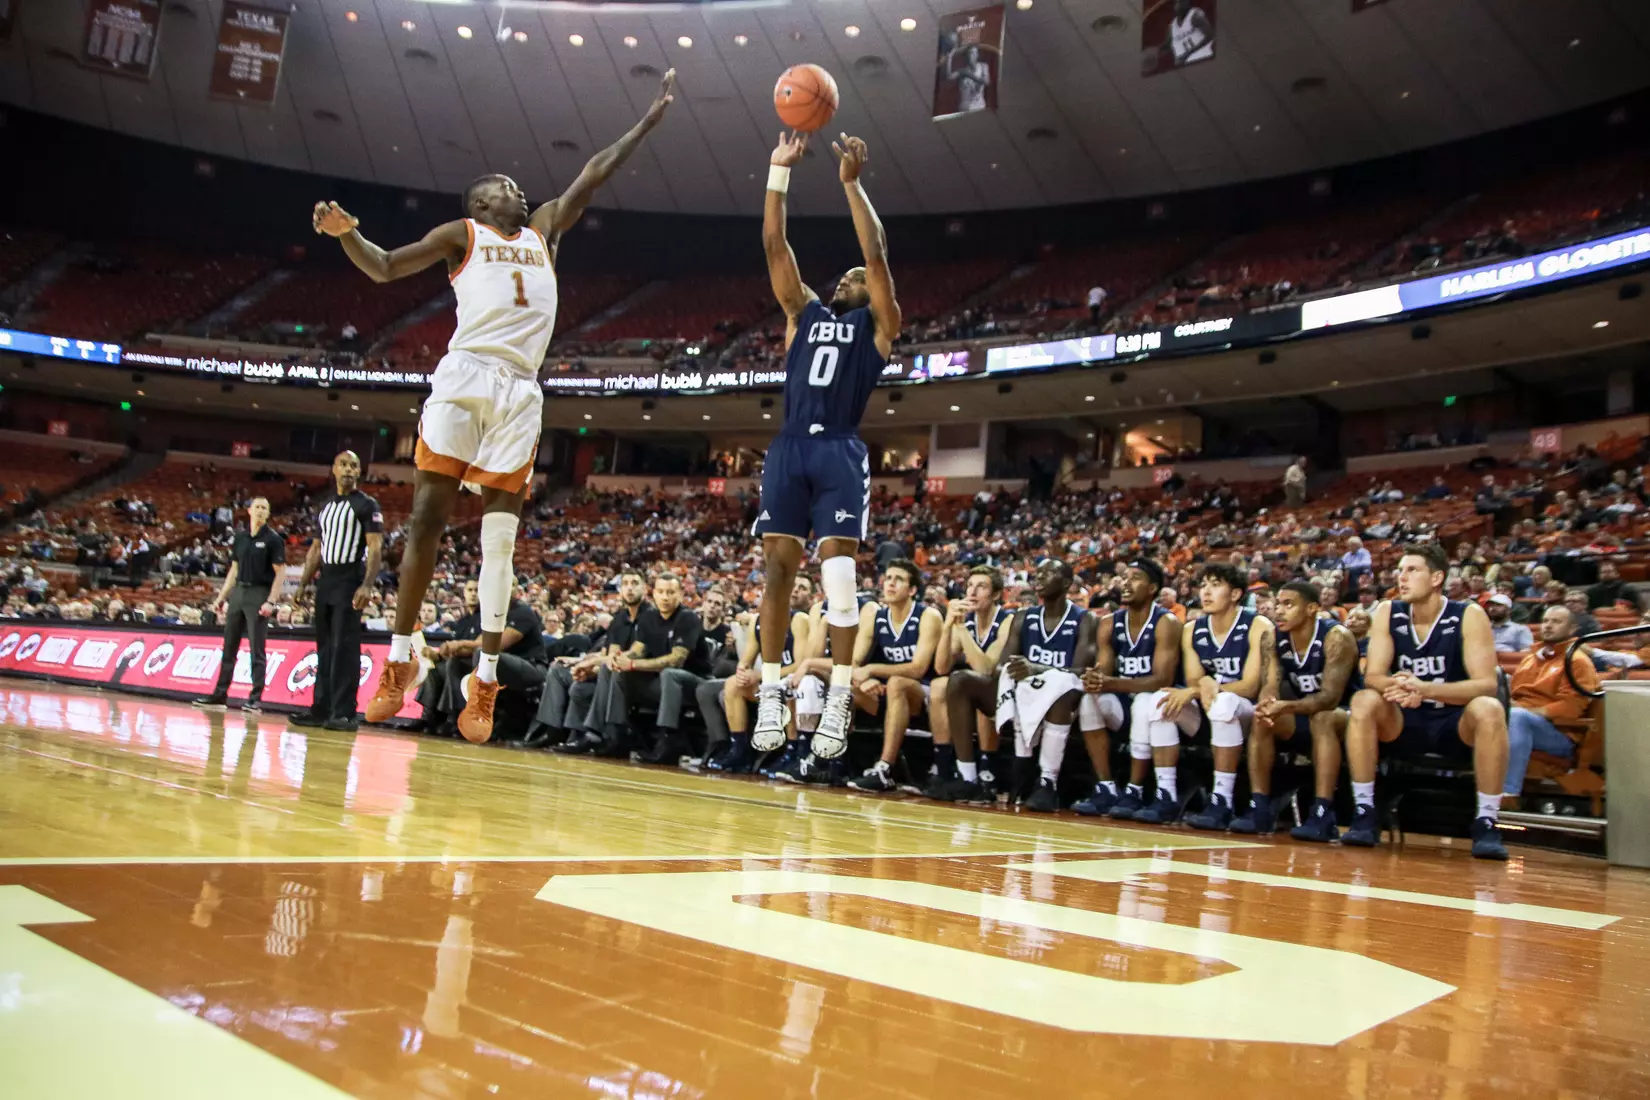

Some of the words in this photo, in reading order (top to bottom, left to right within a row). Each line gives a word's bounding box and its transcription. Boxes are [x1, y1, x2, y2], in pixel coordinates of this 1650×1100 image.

[479, 245, 545, 268] TEXAS
[511, 271, 529, 307] 1
[1440, 261, 1536, 298] HARLEM
[807, 321, 855, 344] CBU
[186, 357, 242, 375] michael
[287, 365, 319, 379] APRIL
[808, 345, 840, 387] 0
[604, 373, 658, 390] michael
[706, 373, 738, 387] APRIL
[1534, 432, 1557, 448] 49
[1028, 644, 1067, 668] CBU
[1398, 654, 1446, 677] CBU
